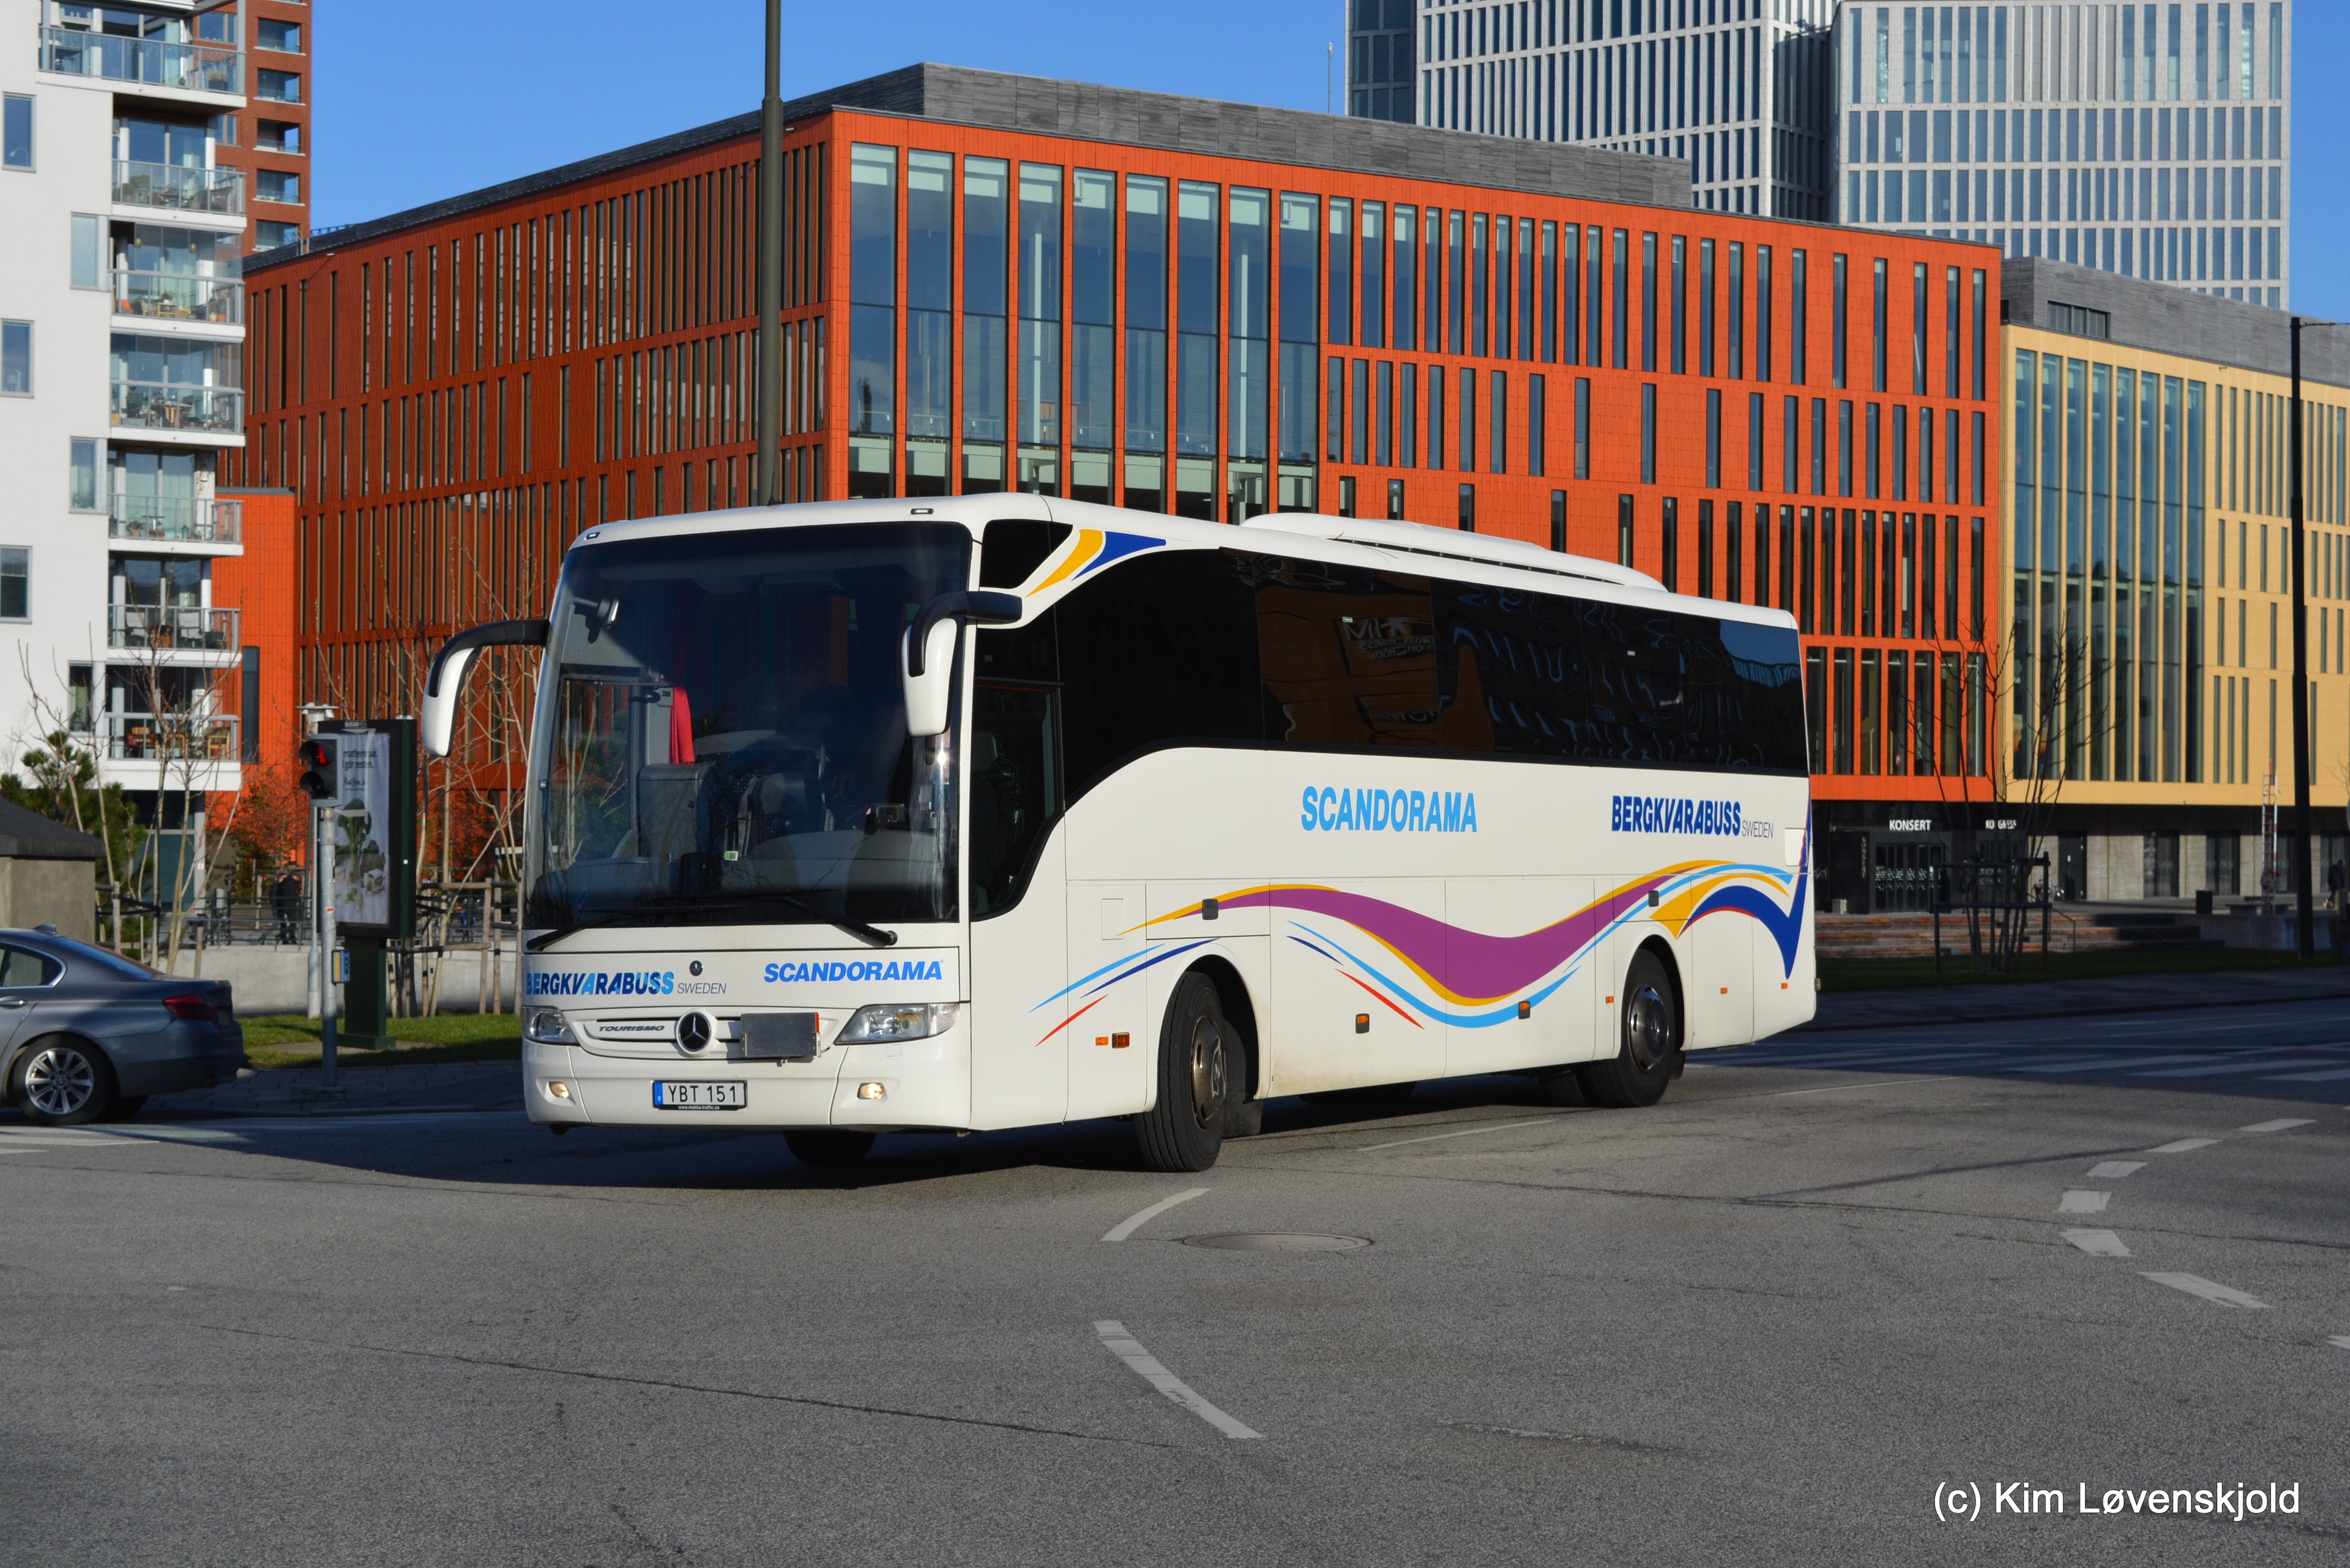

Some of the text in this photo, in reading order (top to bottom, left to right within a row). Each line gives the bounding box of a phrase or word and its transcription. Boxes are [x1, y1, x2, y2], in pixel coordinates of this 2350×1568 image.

[1301, 786, 1477, 832] SCANDORAMA
[1611, 795, 1774, 838] BERGKVARABUSS SWEDEN
[1889, 819, 1932, 831] KONSERT
[764, 961, 942, 982] SCANDORAMA
[526, 971, 727, 995] BERGKVARABUSS SWEDEN
[668, 1085, 736, 1103] YBT 151
